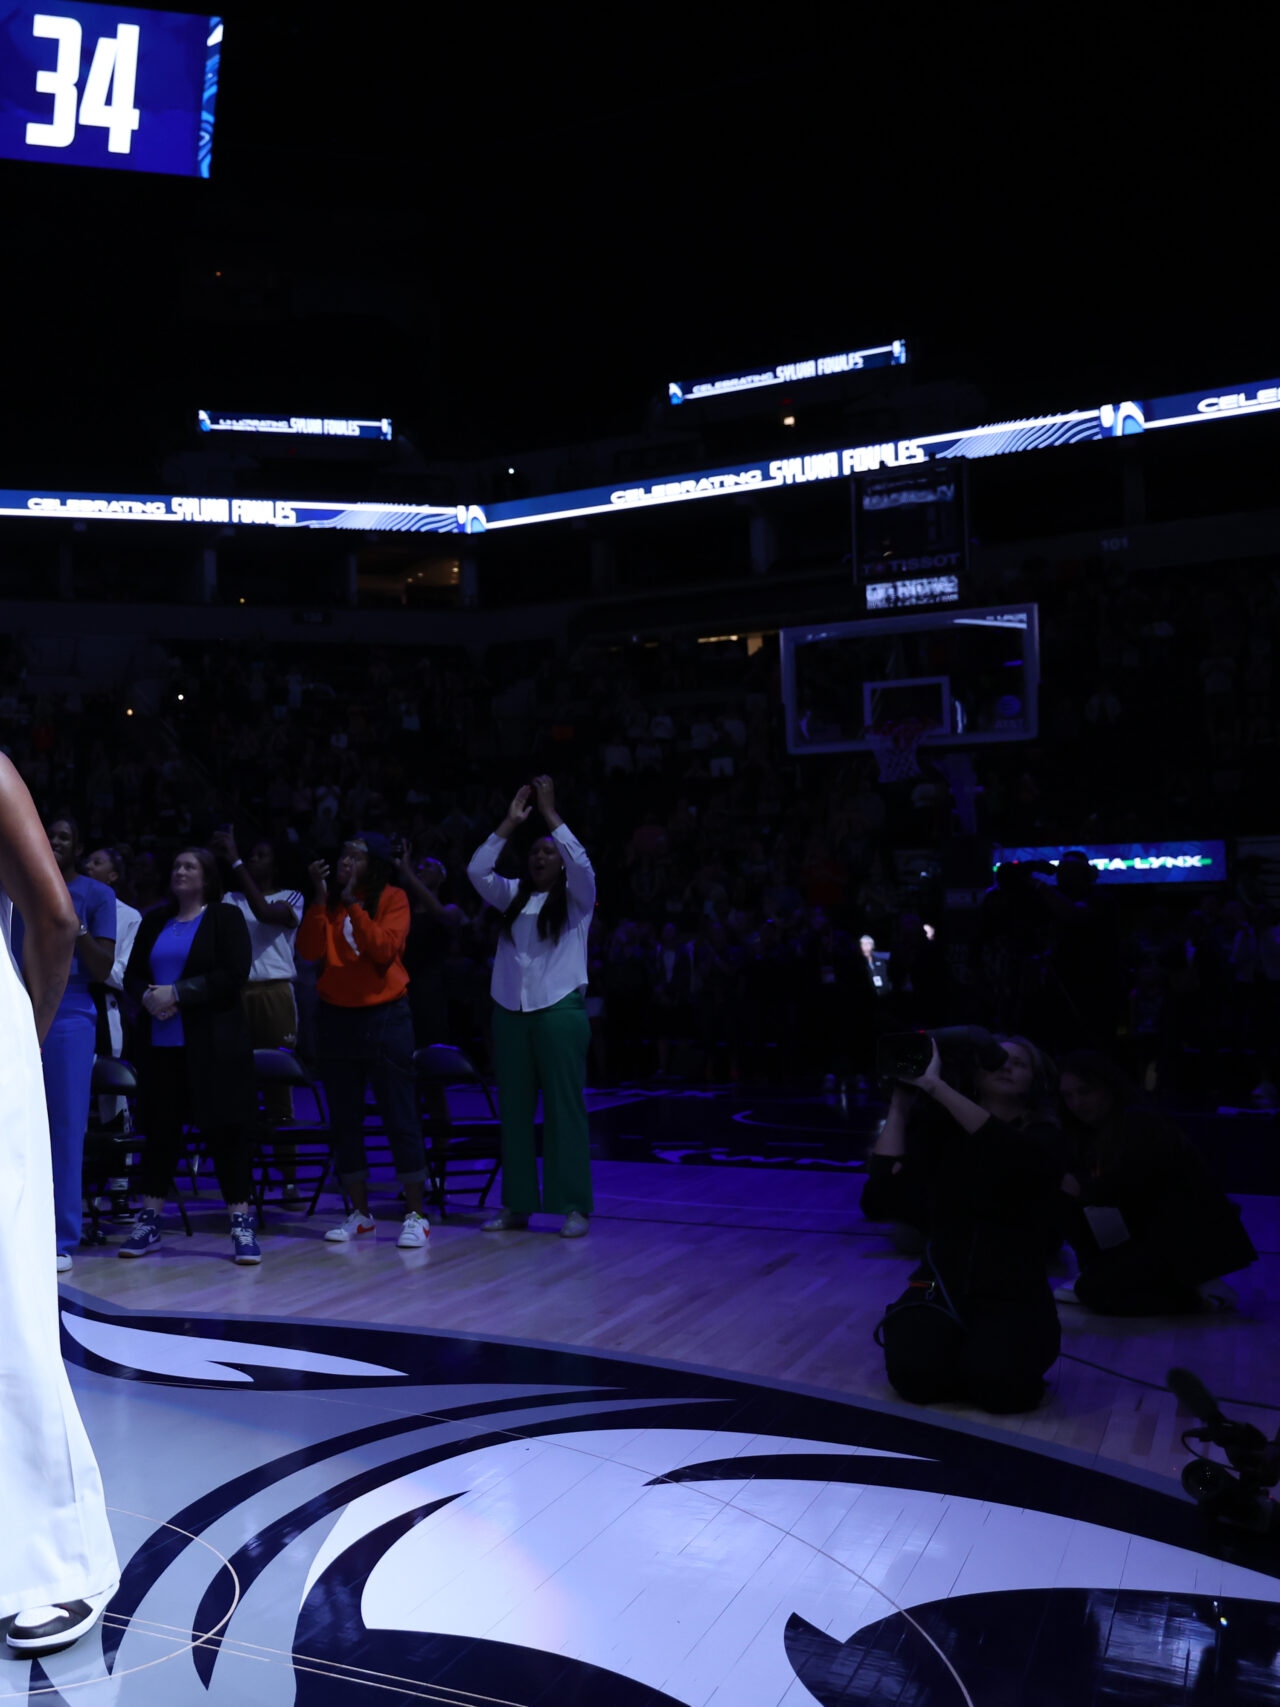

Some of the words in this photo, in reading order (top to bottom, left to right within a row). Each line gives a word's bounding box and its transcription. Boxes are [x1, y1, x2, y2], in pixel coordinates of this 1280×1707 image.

[25, 14, 140, 154] 34
[776, 359, 817, 382] SYLVIA
[817, 352, 865, 375] FOWLES
[1197, 387, 1280, 413] CELE
[324, 419, 360, 436] FOWLES
[610, 469, 763, 505] CELEBRATING
[769, 451, 839, 487] SYLVIA
[842, 438, 926, 476] FOWLES
[27, 497, 166, 515] CELEBRATING
[171, 497, 229, 523] SYLVIA
[231, 499, 297, 525] FOWLES
[888, 552, 960, 573] TISSOT
[1133, 854, 1203, 869] LYNX
